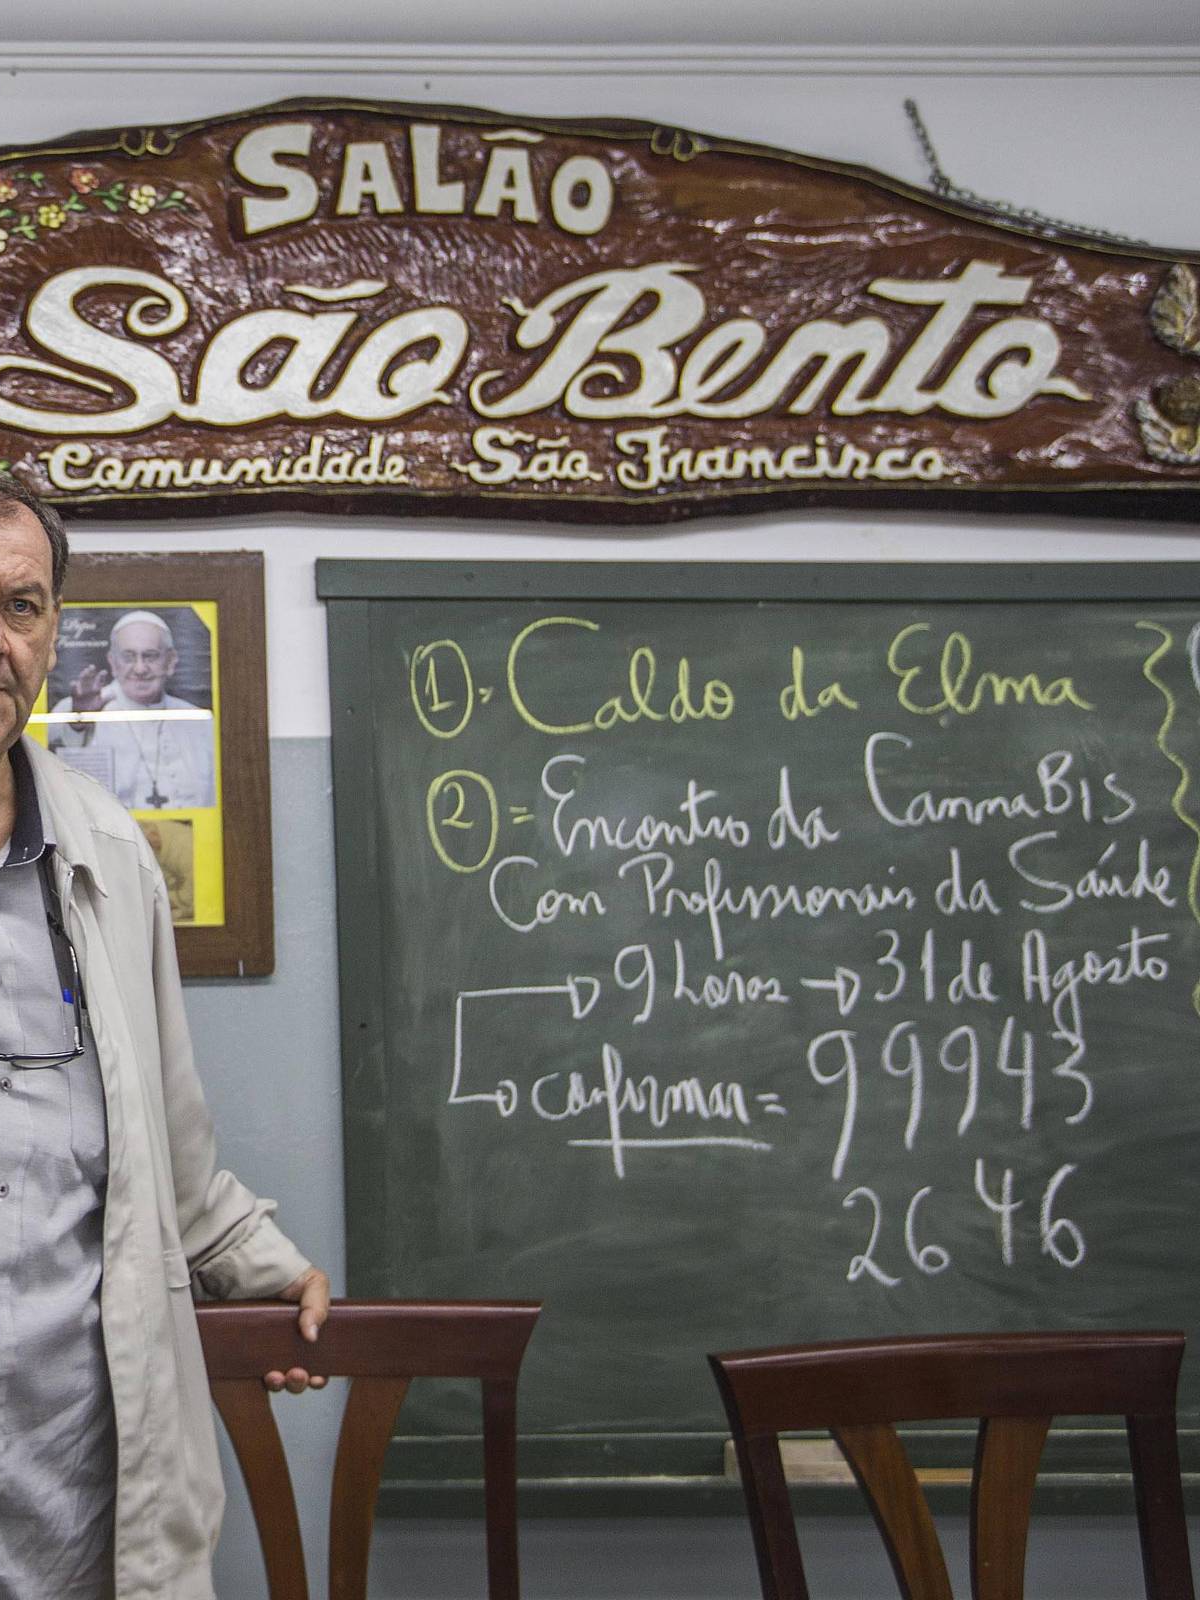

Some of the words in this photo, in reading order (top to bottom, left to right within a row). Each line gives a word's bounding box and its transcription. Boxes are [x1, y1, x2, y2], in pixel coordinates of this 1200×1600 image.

[233, 122, 615, 236] SALÃO
[470, 258, 1093, 421] Bento
[38, 434, 409, 491] Comunidade
[450, 425, 603, 485] São
[615, 426, 955, 490] Francisco
[507, 616, 736, 735] Caldo
[780, 645, 859, 721] da
[767, 765, 841, 850] da
[935, 845, 1001, 916] da
[874, 927, 936, 1002] 31
[947, 938, 1000, 1004] de
[1021, 926, 1171, 1040] Agosto
